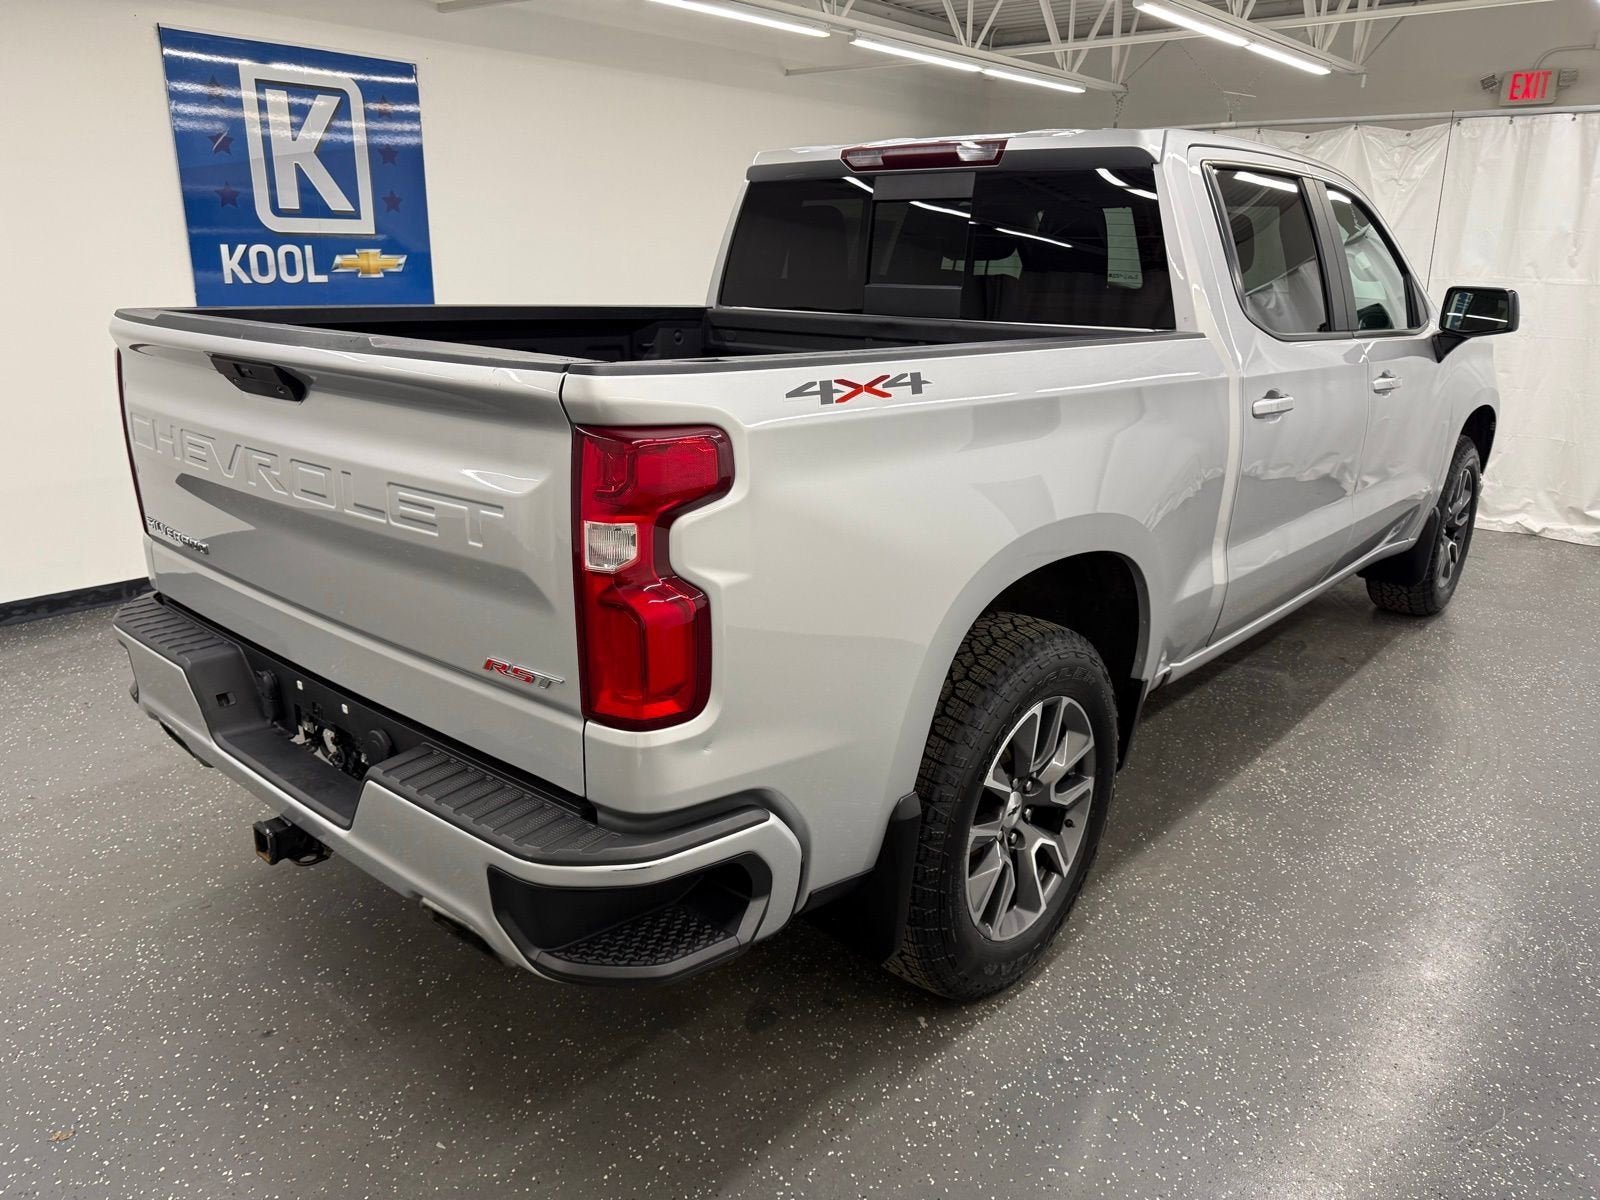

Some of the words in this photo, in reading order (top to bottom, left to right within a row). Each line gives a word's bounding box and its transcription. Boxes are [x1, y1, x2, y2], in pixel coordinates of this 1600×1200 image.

[1508, 70, 1552, 101] EXIT
[265, 88, 355, 212] K
[220, 243, 329, 285] KOOL
[130, 411, 504, 548] CHEVROLET
[484, 657, 564, 689] RST
